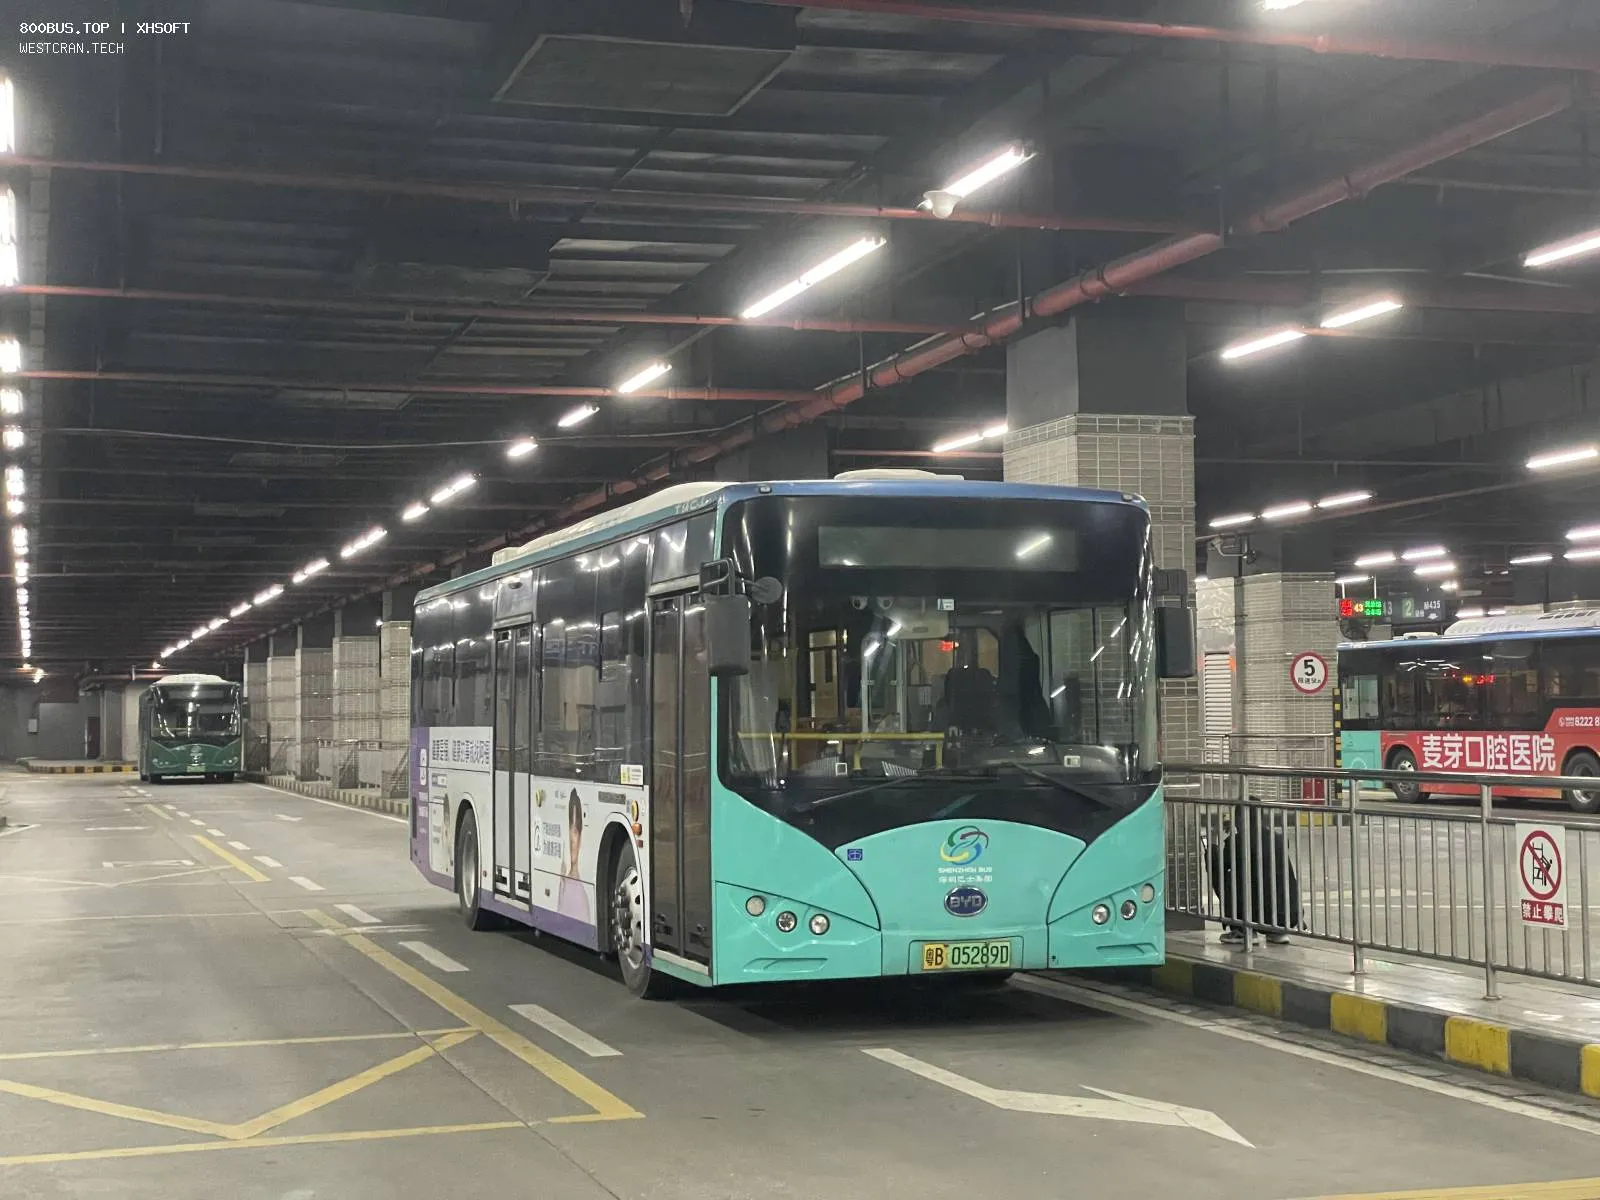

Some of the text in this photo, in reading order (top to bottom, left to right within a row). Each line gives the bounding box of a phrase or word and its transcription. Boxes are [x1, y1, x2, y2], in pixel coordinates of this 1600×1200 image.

[1405, 600, 1412, 616] 2
[1303, 659, 1315, 676] 5
[1575, 716, 1593, 727] 8222
[1422, 733, 1556, 772] 麦芽口腔医院
[950, 895, 983, 908] BYD
[1522, 902, 1564, 923] 禁止攀爬
